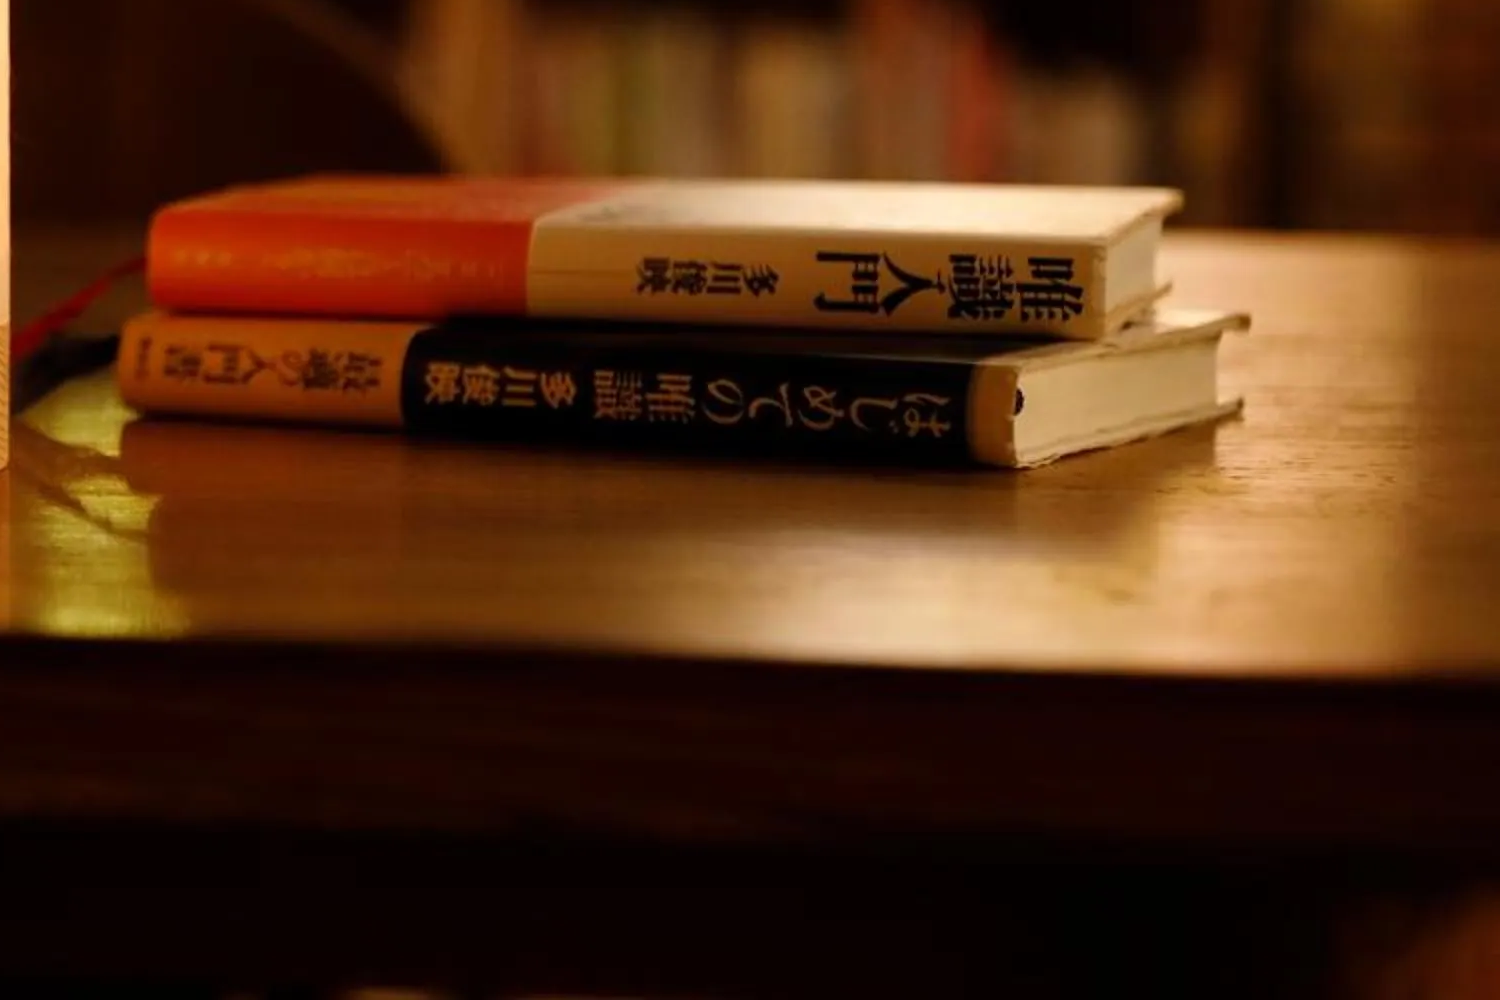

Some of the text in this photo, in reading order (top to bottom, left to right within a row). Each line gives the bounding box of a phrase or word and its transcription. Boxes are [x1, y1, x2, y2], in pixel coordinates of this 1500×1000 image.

[636, 257, 780, 299] 多川俊映
[814, 251, 1085, 324] 唯識入門
[424, 361, 578, 410] 多川俊映
[593, 369, 952, 438] はじめての唯識
